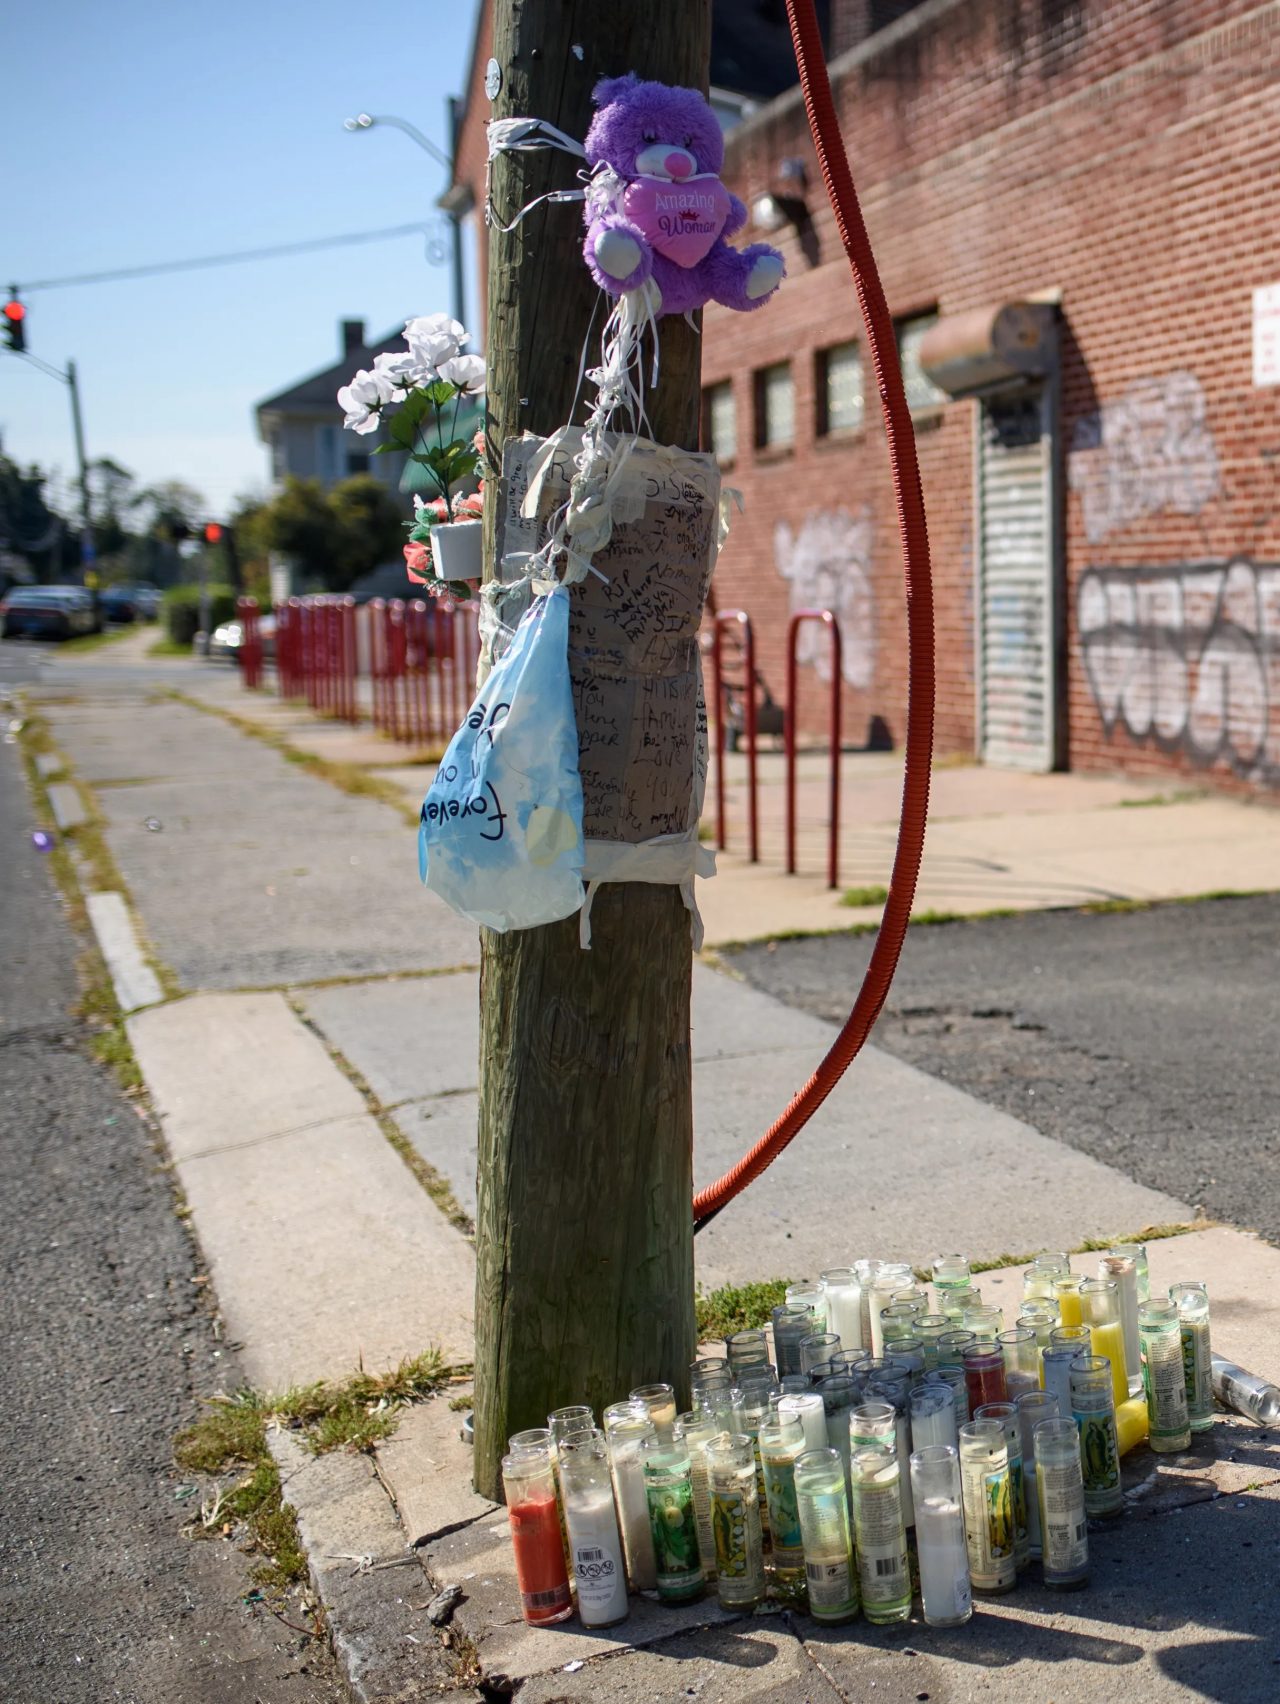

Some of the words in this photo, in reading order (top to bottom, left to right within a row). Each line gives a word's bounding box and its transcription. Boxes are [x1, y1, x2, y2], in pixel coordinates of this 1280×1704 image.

[655, 191, 716, 211] Amazing
[658, 215, 716, 237] Woman
[435, 765, 457, 784] ou
[420, 780, 507, 841] Forever
